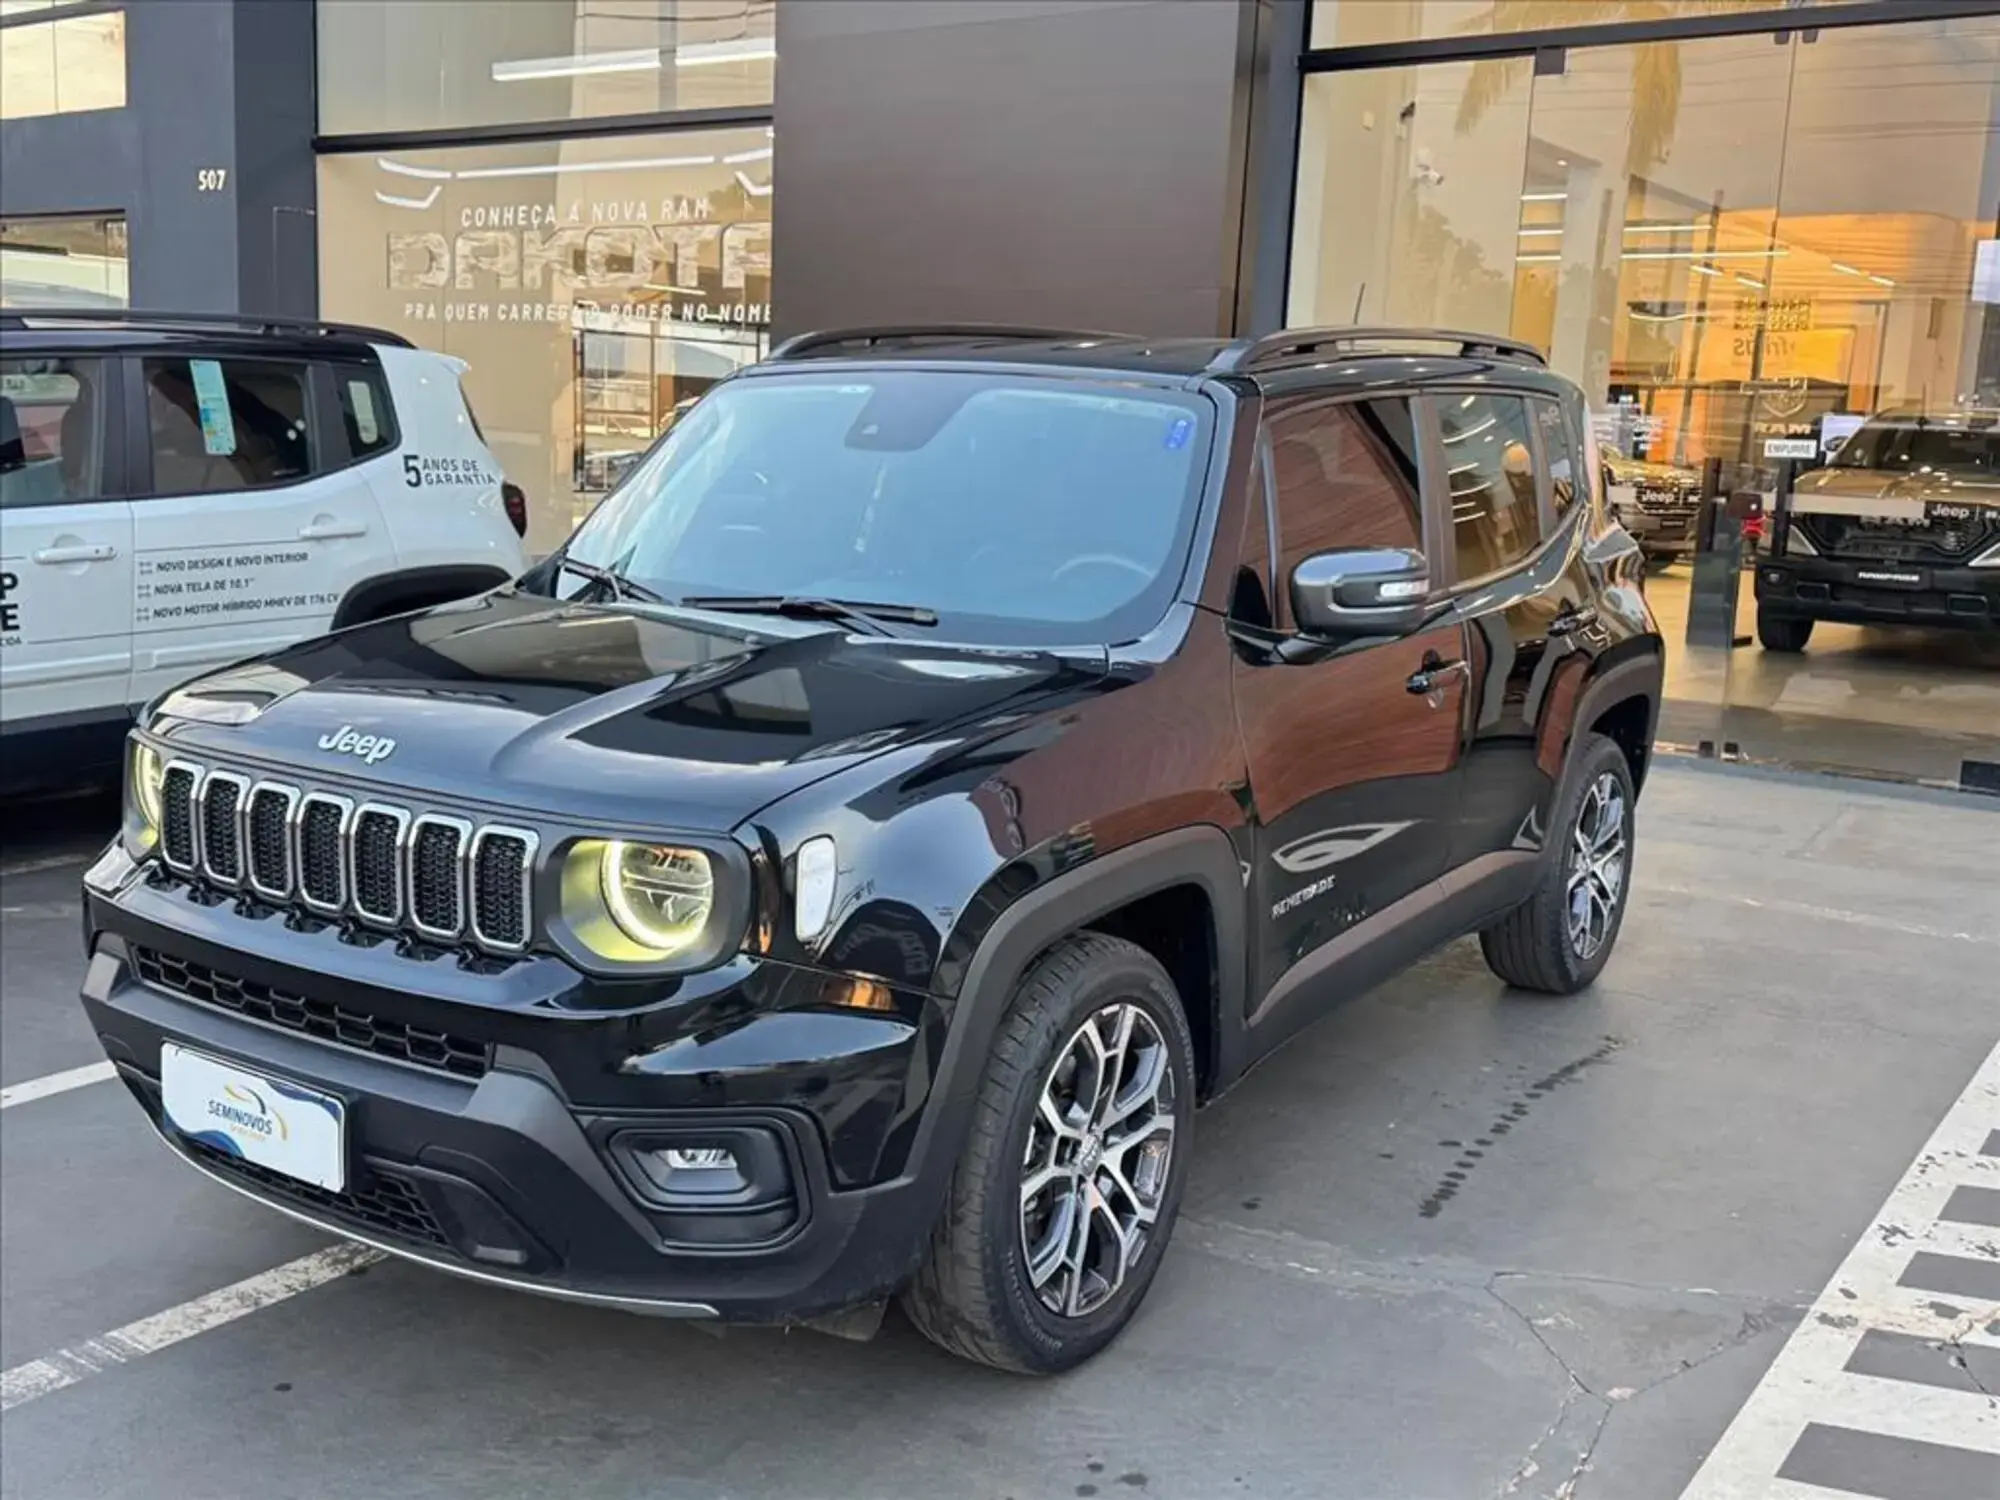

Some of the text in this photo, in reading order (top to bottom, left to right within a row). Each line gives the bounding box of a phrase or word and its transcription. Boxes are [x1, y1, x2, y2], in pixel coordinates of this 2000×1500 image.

[198, 169, 226, 191] 507
[461, 203, 557, 229] CONHEÇA
[592, 200, 648, 223] NOVA
[661, 198, 709, 220] RAM
[404, 302, 437, 321] PRA
[445, 302, 490, 321] QUEM
[682, 303, 708, 322] NO
[403, 454, 479, 487] 5 ANOS DE
[424, 472, 497, 485] GARANTIA
[1932, 503, 1969, 519] Jeep
[157, 551, 309, 572] NOVO DESIGN E NOVO INTERIOR
[154, 582, 184, 595] NOVA
[186, 580, 212, 592] TELA
[213, 579, 227, 590] DE
[153, 606, 182, 619] NOVO
[184, 601, 220, 615] MOTOR
[294, 595, 306, 606] DE
[318, 725, 397, 765] Jeep
[208, 1099, 273, 1136] SEMINOVOS
